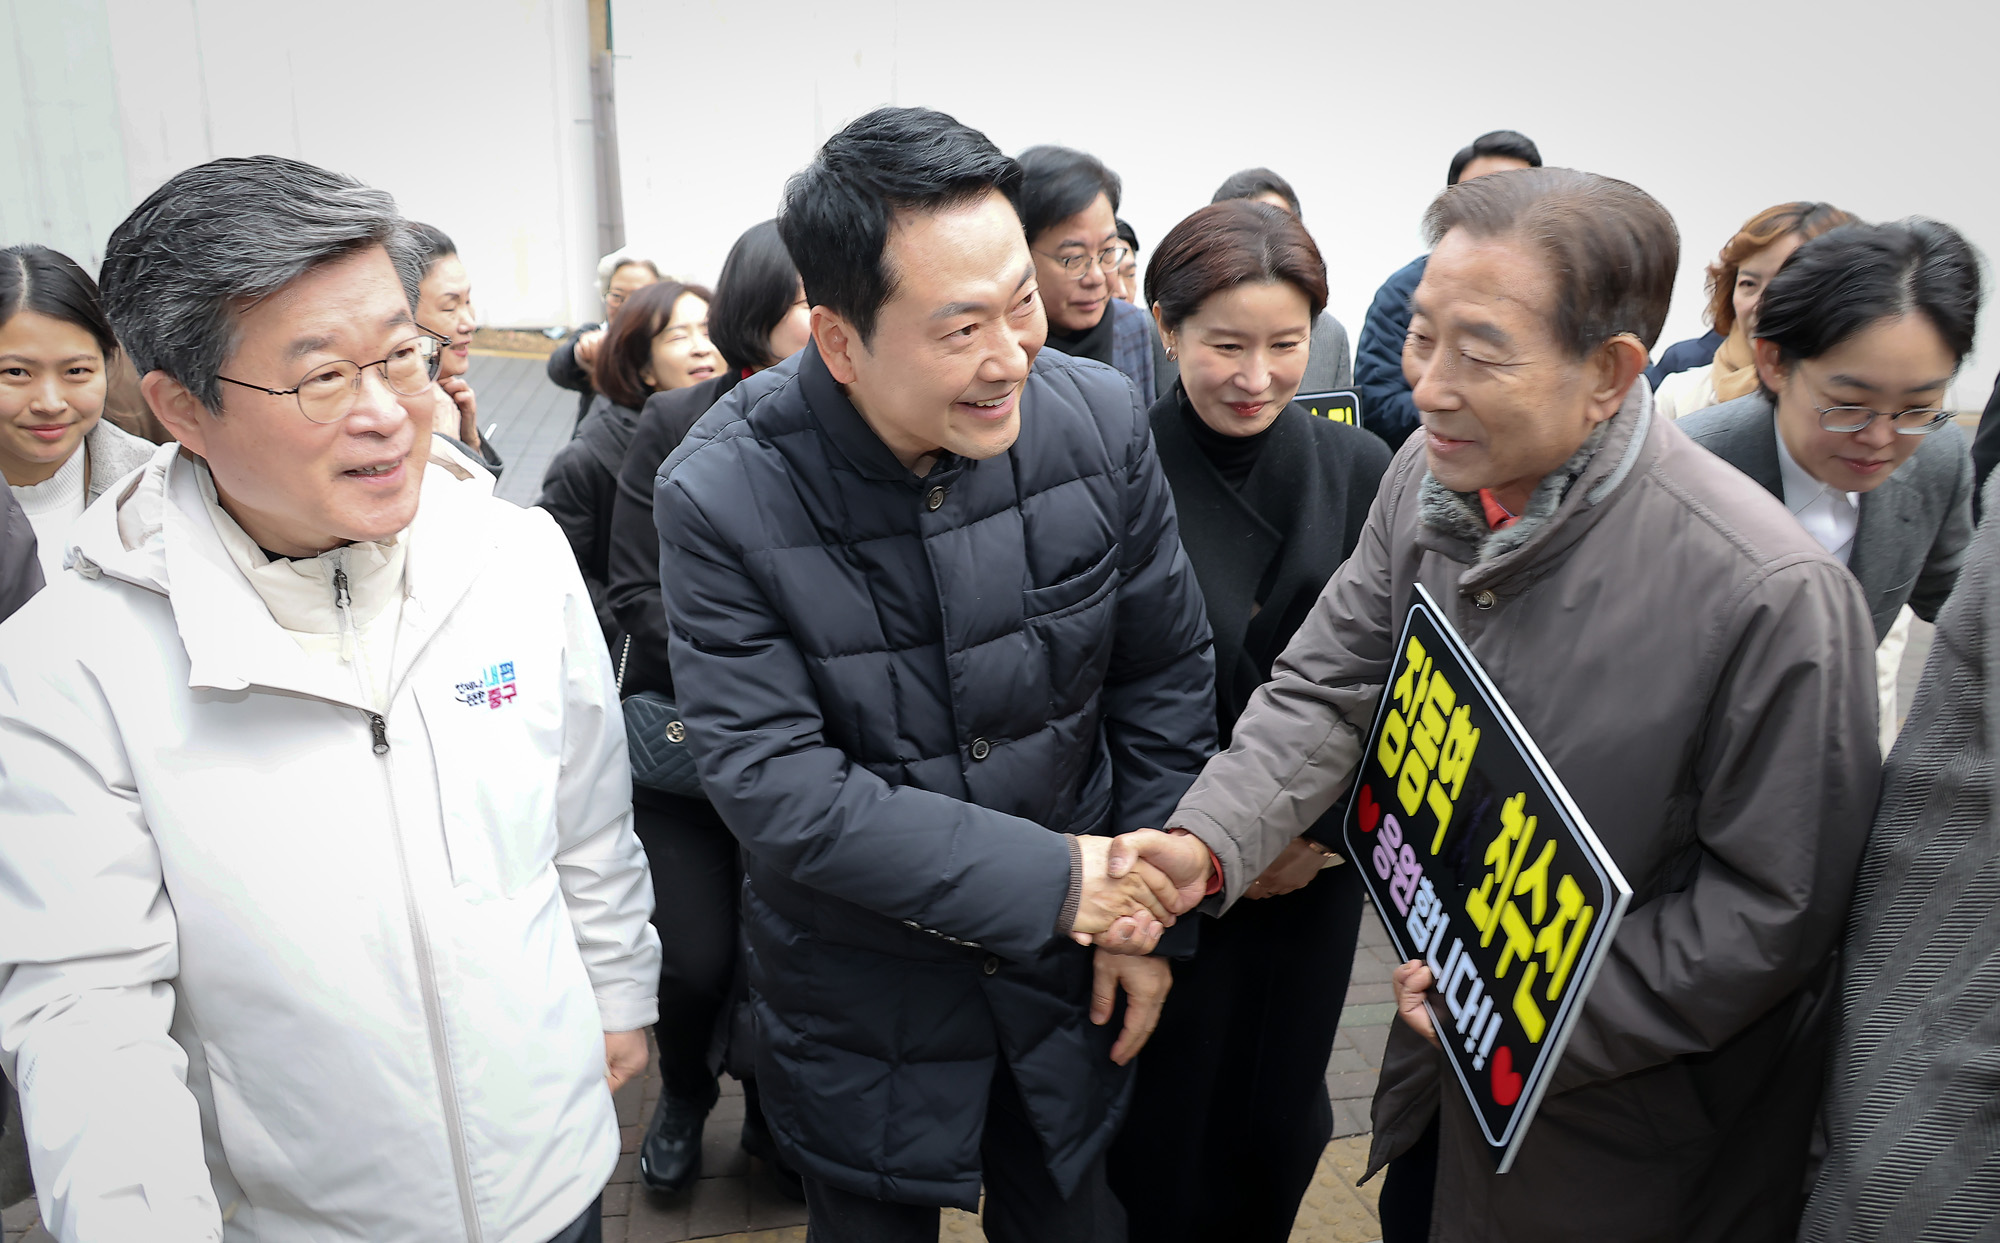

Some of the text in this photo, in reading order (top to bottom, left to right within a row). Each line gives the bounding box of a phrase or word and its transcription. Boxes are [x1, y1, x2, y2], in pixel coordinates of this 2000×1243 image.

[1372, 813, 1503, 1071] 응원합니다!!
[1377, 635, 1594, 1043] 장동혁 최수진
